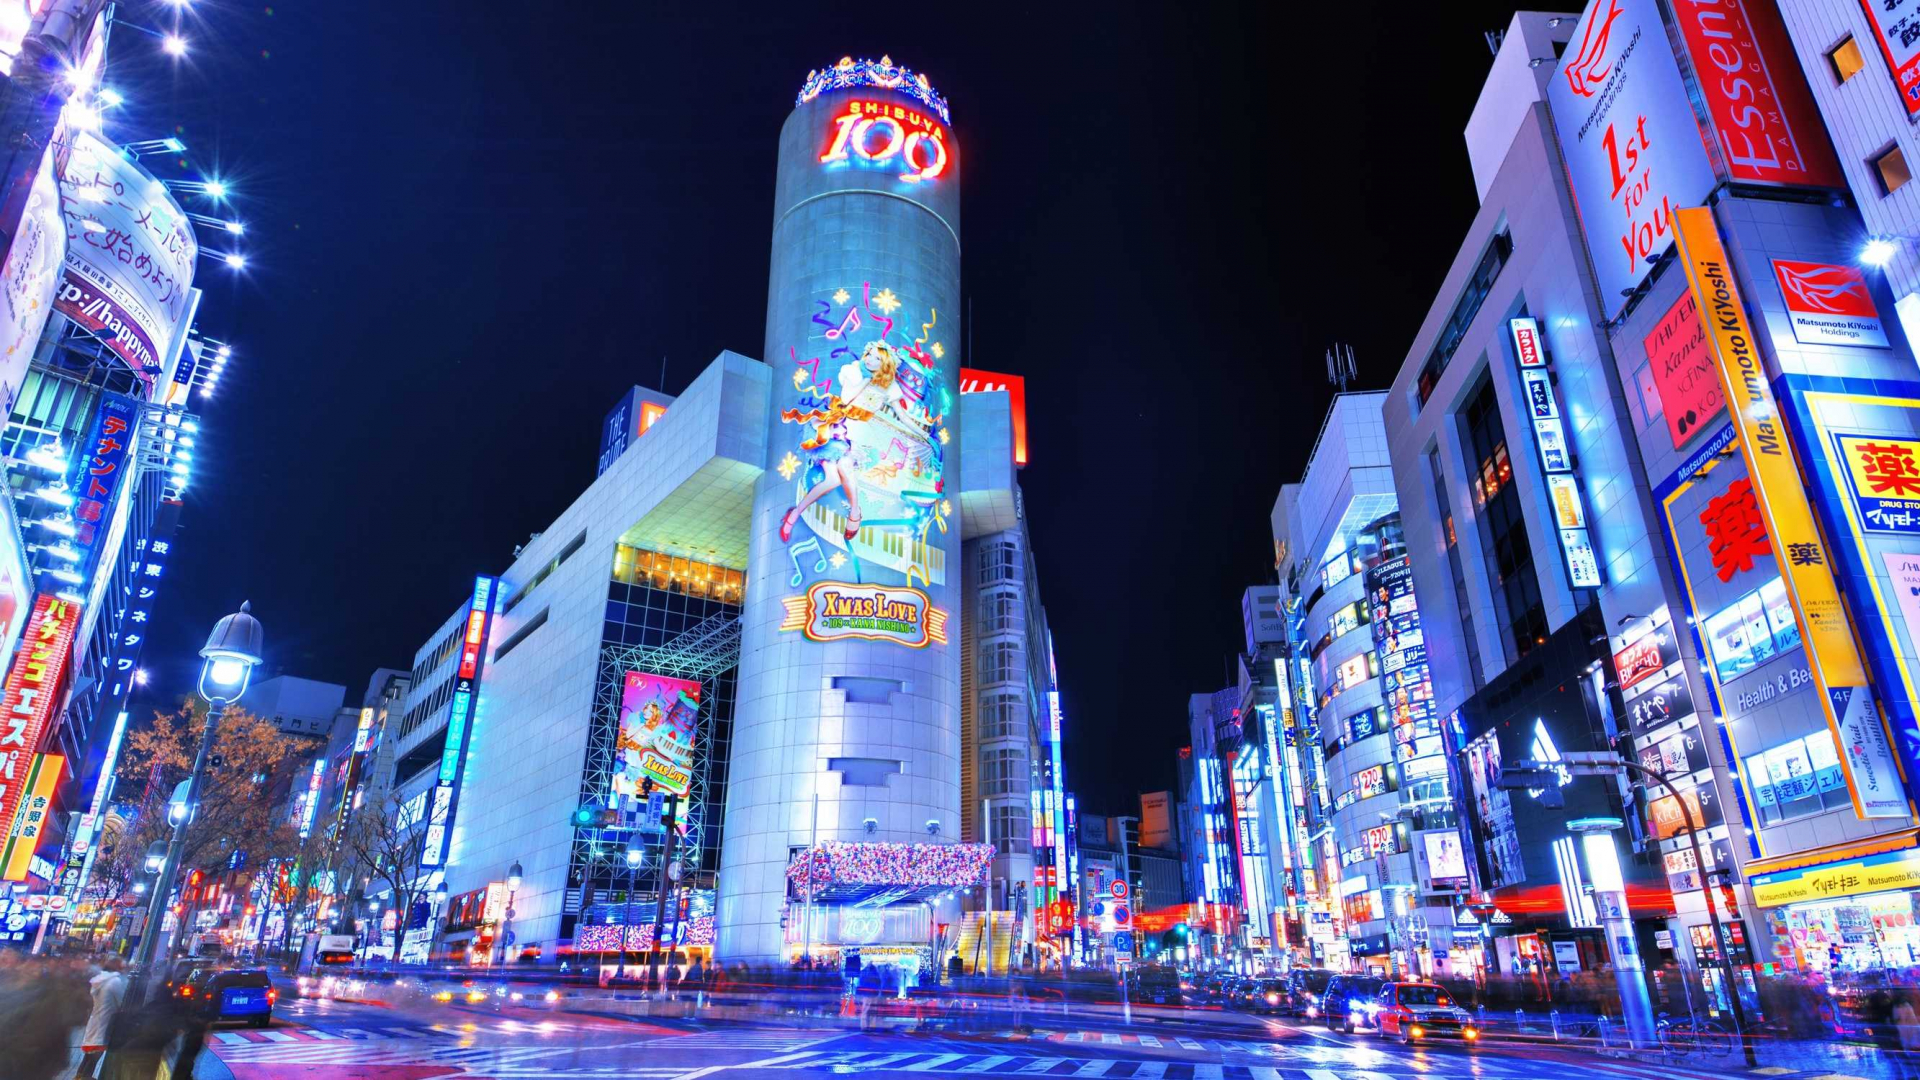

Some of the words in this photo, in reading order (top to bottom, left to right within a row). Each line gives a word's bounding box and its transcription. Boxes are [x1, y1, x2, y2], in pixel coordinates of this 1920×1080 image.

[1577, 74, 1615, 143] Matsumoto
[1613, 26, 1642, 80] KiYoshi
[1595, 71, 1628, 129] Holdings
[849, 101, 943, 140] SHIBUYA
[818, 112, 948, 183] 109
[1601, 114, 1650, 201] 1st
[1623, 167, 1650, 218] for
[1700, 261, 1741, 337] KiYoshi
[1797, 317, 1847, 330] Matsumoto
[1847, 321, 1879, 332] KiYoshi
[1820, 327, 1860, 338] Holdings
[1519, 330, 1536, 363] カラオケ
[1531, 383, 1549, 413] まなや
[608, 405, 626, 447] THE
[1676, 437, 1723, 482] Matsumoto
[1855, 442, 1920, 497] 薬
[1879, 499, 1903, 510] DRUG
[1700, 476, 1774, 584] 薬
[1787, 542, 1824, 567] 薬
[112, 540, 170, 696] 渋東シネタワー
[850, 618, 876, 630] KANA
[876, 620, 910, 634] NISHINO
[24, 598, 69, 683] パチンコ
[1633, 695, 1666, 726] まなや
[1737, 682, 1775, 712] Health
[1777, 674, 1790, 694] &
[1833, 690, 1851, 702] 4F
[1849, 724, 1867, 751] Nail
[1361, 768, 1378, 790] 270
[1861, 750, 1880, 793] Sweetie
[22, 796, 47, 838] 吉野家
[1369, 827, 1388, 849] 270
[1114, 884, 1125, 894] 30
[1759, 891, 1788, 902] Matsumoto
[1787, 887, 1808, 899] KiYoshi
[1867, 872, 1906, 886] Matsumoto
[1609, 906, 1620, 917] 2
